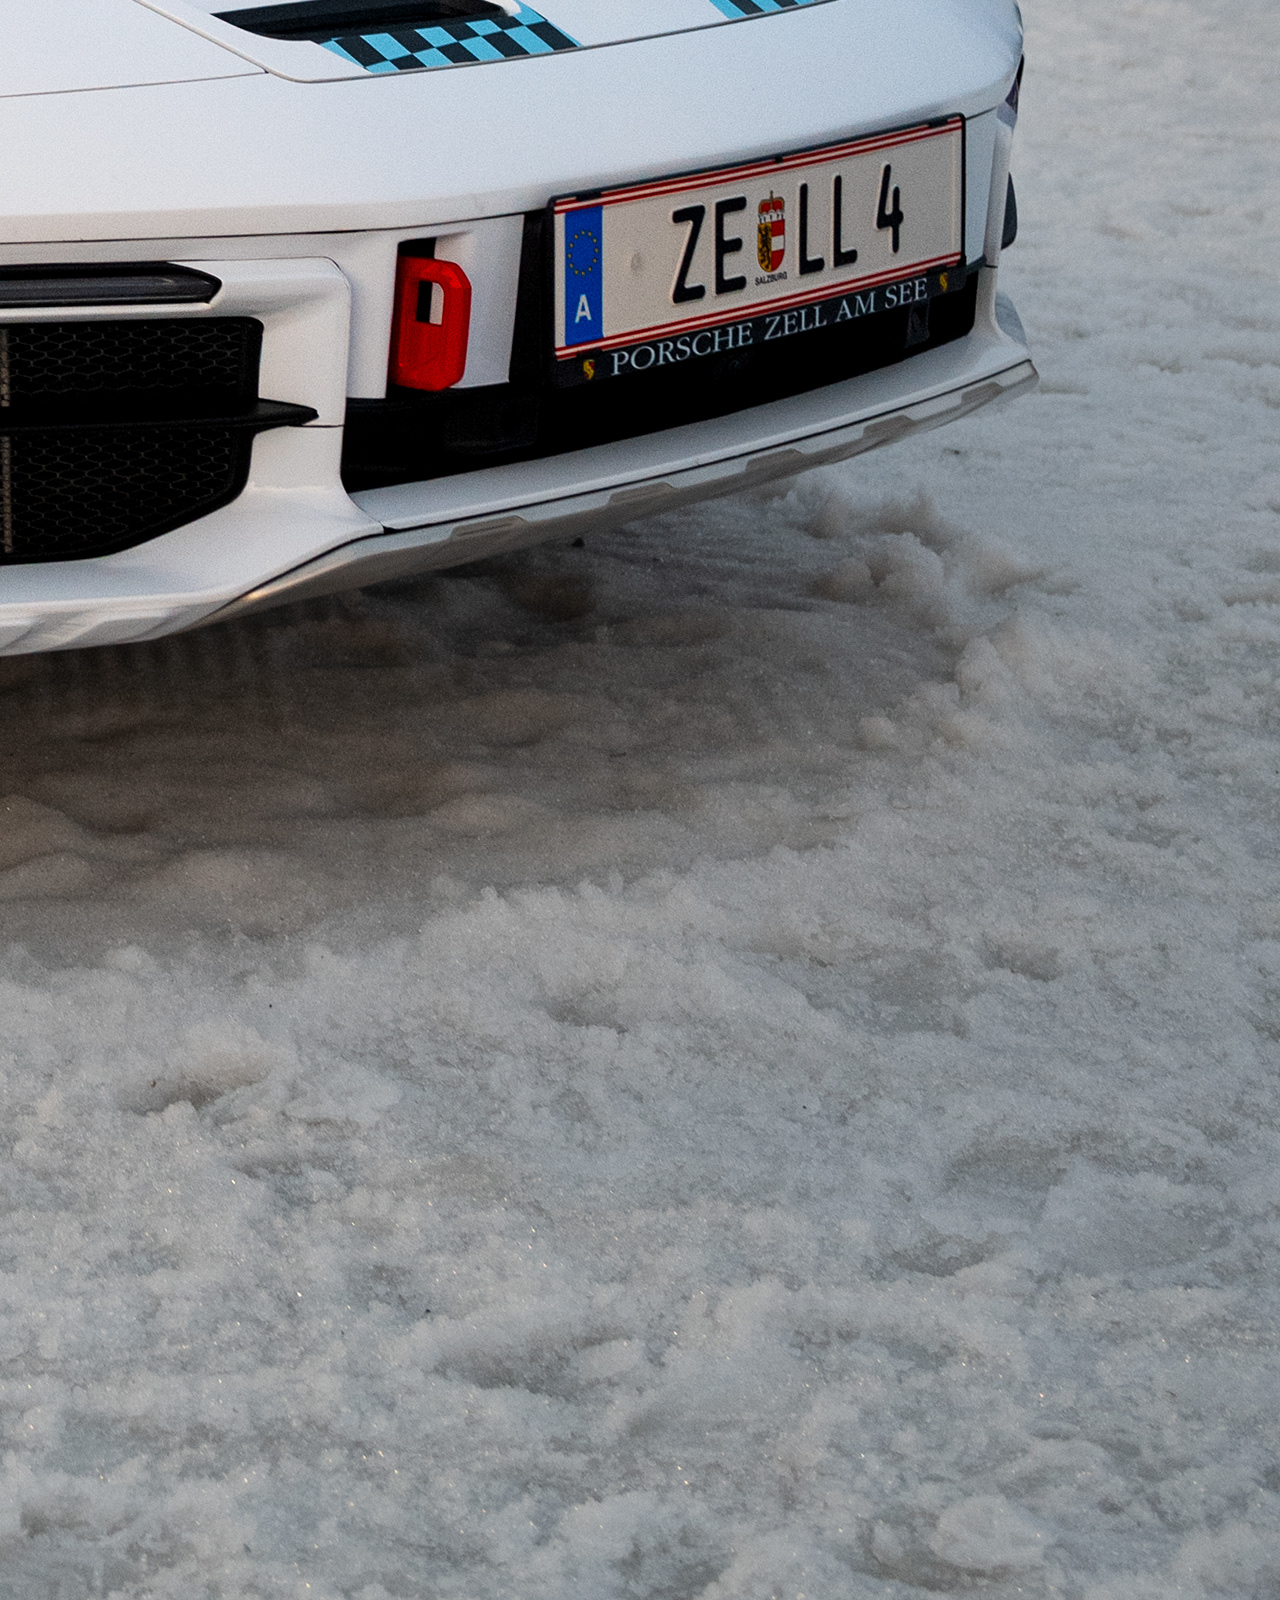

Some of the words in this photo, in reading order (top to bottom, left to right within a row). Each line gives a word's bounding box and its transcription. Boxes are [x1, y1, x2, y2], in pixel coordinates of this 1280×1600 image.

[573, 293, 593, 324] A
[610, 322, 755, 377] PORSCHE
[763, 303, 829, 341] ZELL
[835, 288, 876, 322] AM
[883, 276, 930, 310] SEE
